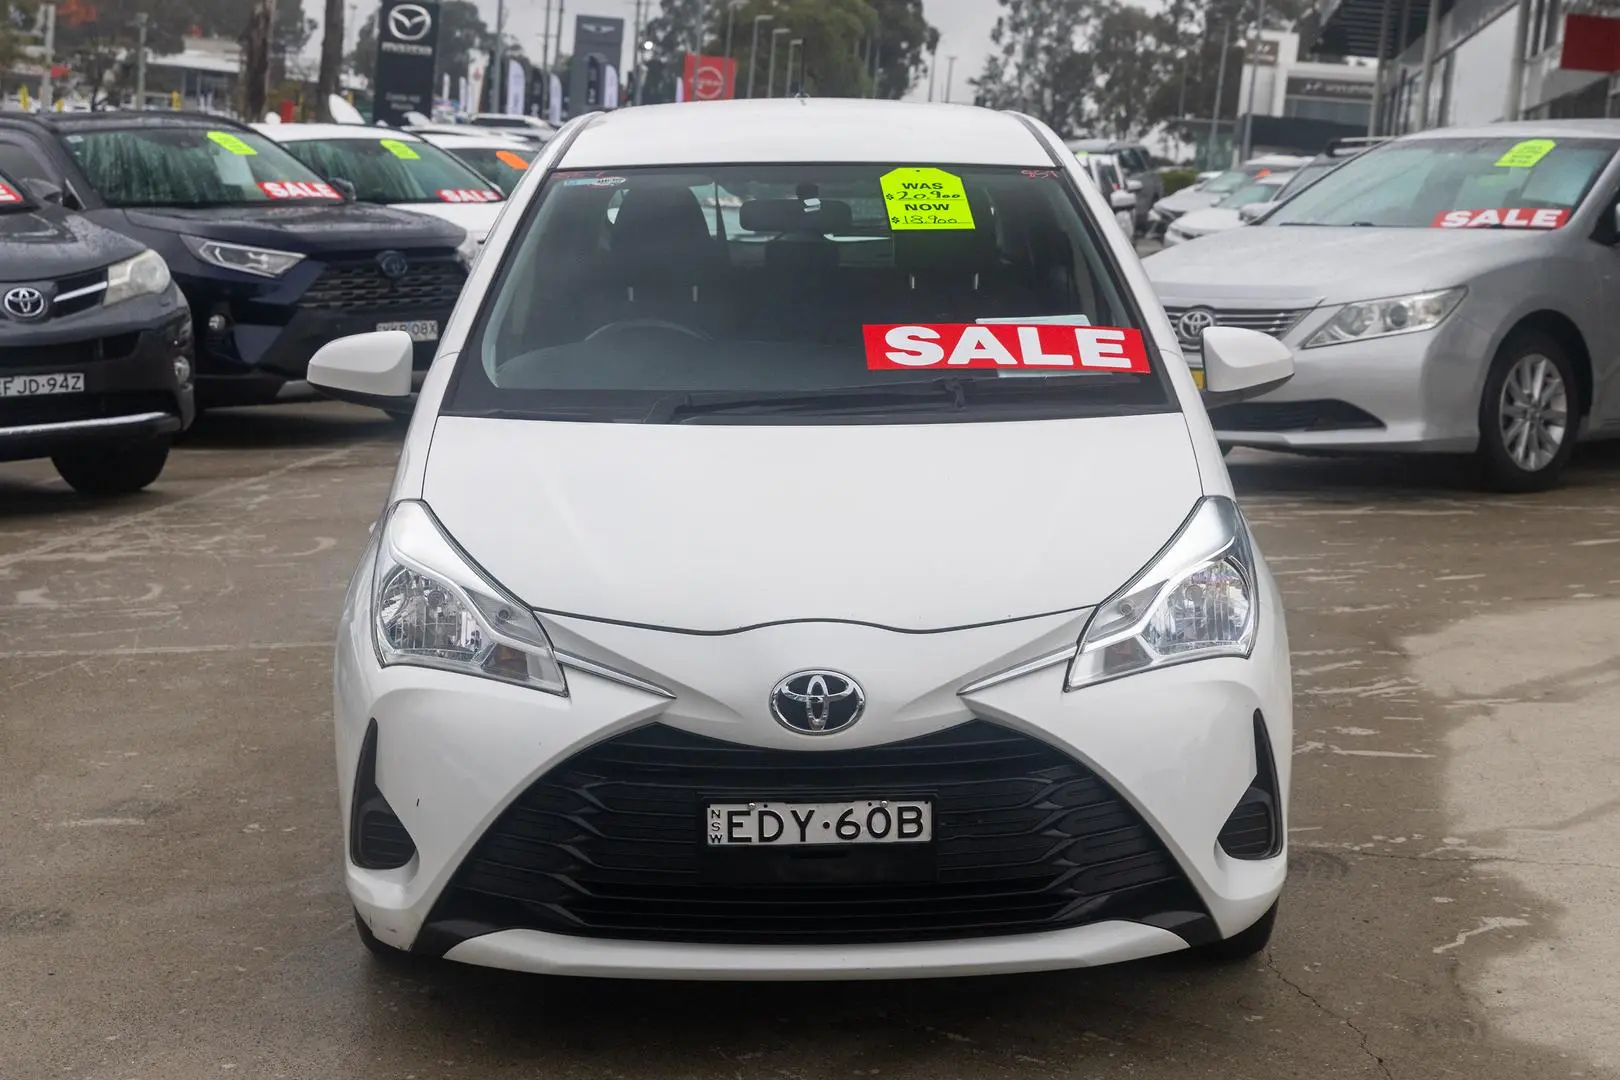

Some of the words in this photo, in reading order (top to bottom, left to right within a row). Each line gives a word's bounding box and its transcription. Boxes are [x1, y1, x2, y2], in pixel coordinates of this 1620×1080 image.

[263, 181, 341, 199] SALE
[902, 182, 943, 190] WAS
[441, 188, 499, 202] SALE
[904, 203, 950, 211] NOW
[1440, 209, 1563, 228] SALE
[884, 325, 1133, 369] SALE
